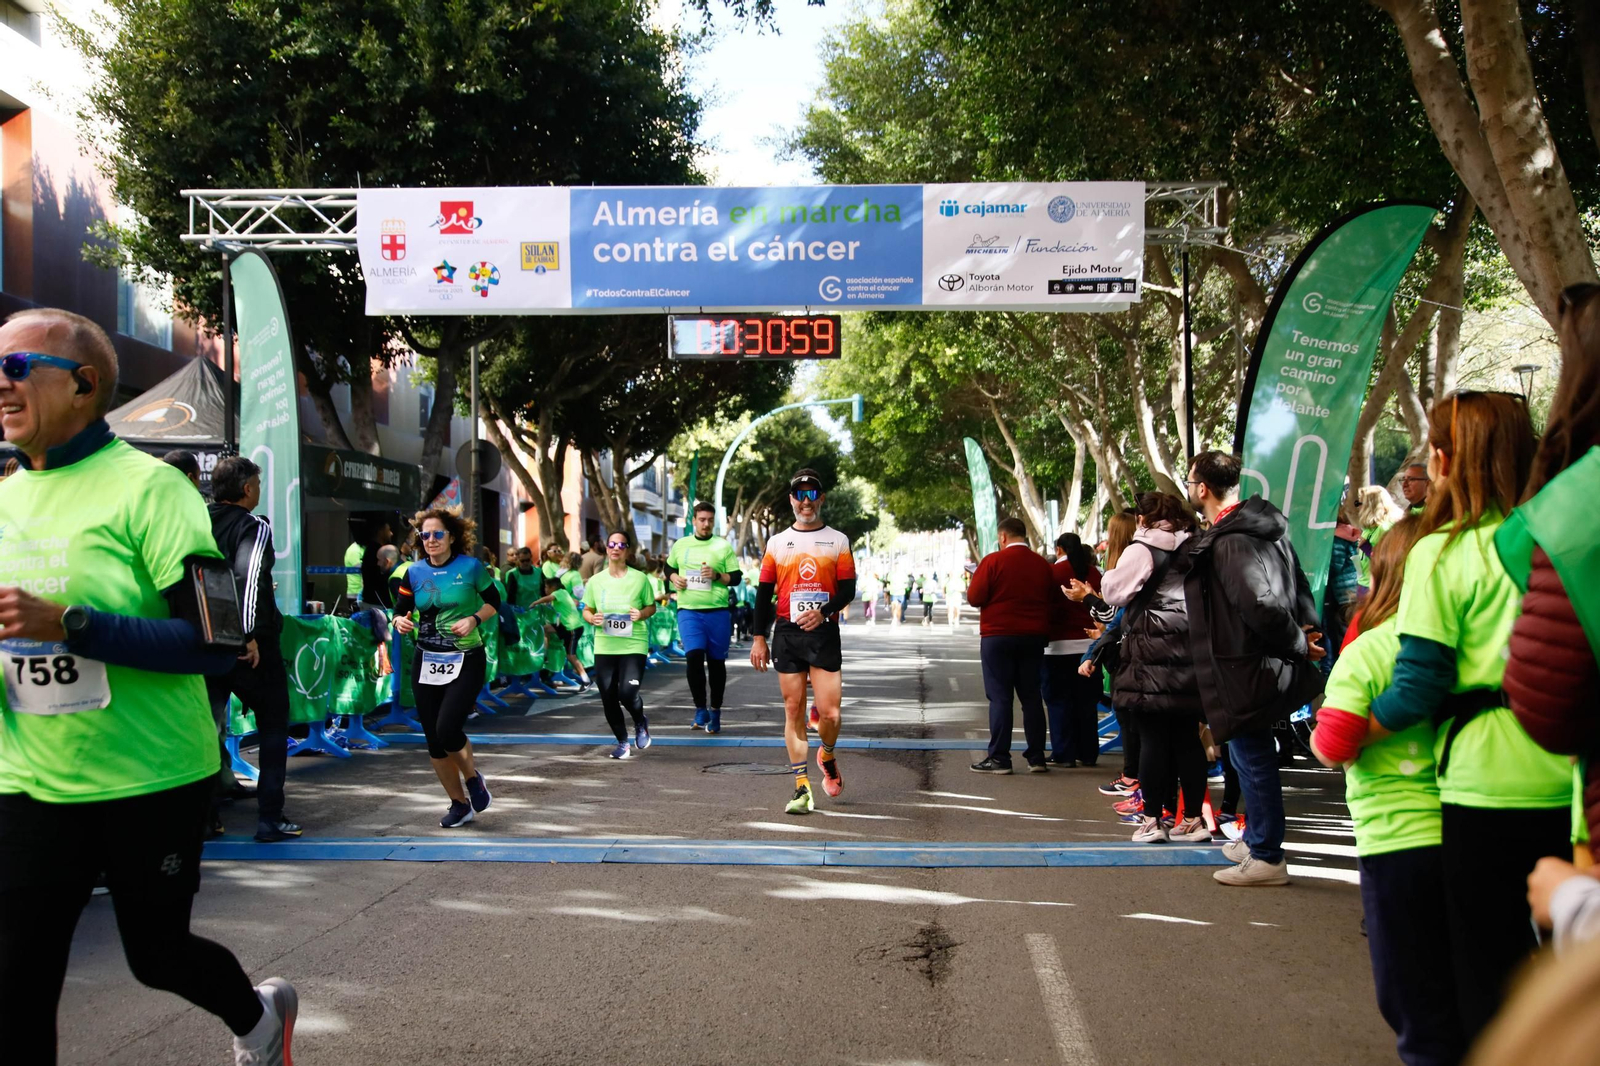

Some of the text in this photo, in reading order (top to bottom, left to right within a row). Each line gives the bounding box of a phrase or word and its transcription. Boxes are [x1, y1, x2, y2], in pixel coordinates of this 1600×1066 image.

[592, 197, 901, 226] Almería en marcha
[964, 201, 1028, 217] cajamar
[593, 235, 860, 263] contra el cáncer
[1025, 239, 1098, 254] Fundación
[369, 265, 417, 277] ALMERÍA
[1062, 264, 1122, 277] Ejido Motor
[884, 276, 913, 285] española
[969, 273, 1000, 283] Toyota
[586, 288, 691, 298] #TodosContraElCáncer
[969, 283, 1004, 292] Alborán
[1078, 284, 1093, 292] Jeep
[1096, 283, 1109, 292] FIAT
[1124, 283, 1134, 292] FIAT
[696, 319, 834, 355] 00:30:59
[1291, 329, 1360, 355] Tenemos
[1285, 348, 1342, 371] un gran
[1280, 364, 1336, 385] camino
[1275, 382, 1303, 397] por
[49, 550, 69, 567] el
[797, 601, 823, 612] 637
[607, 620, 627, 630] 180
[11, 655, 80, 686] 758
[429, 663, 455, 675] 342
